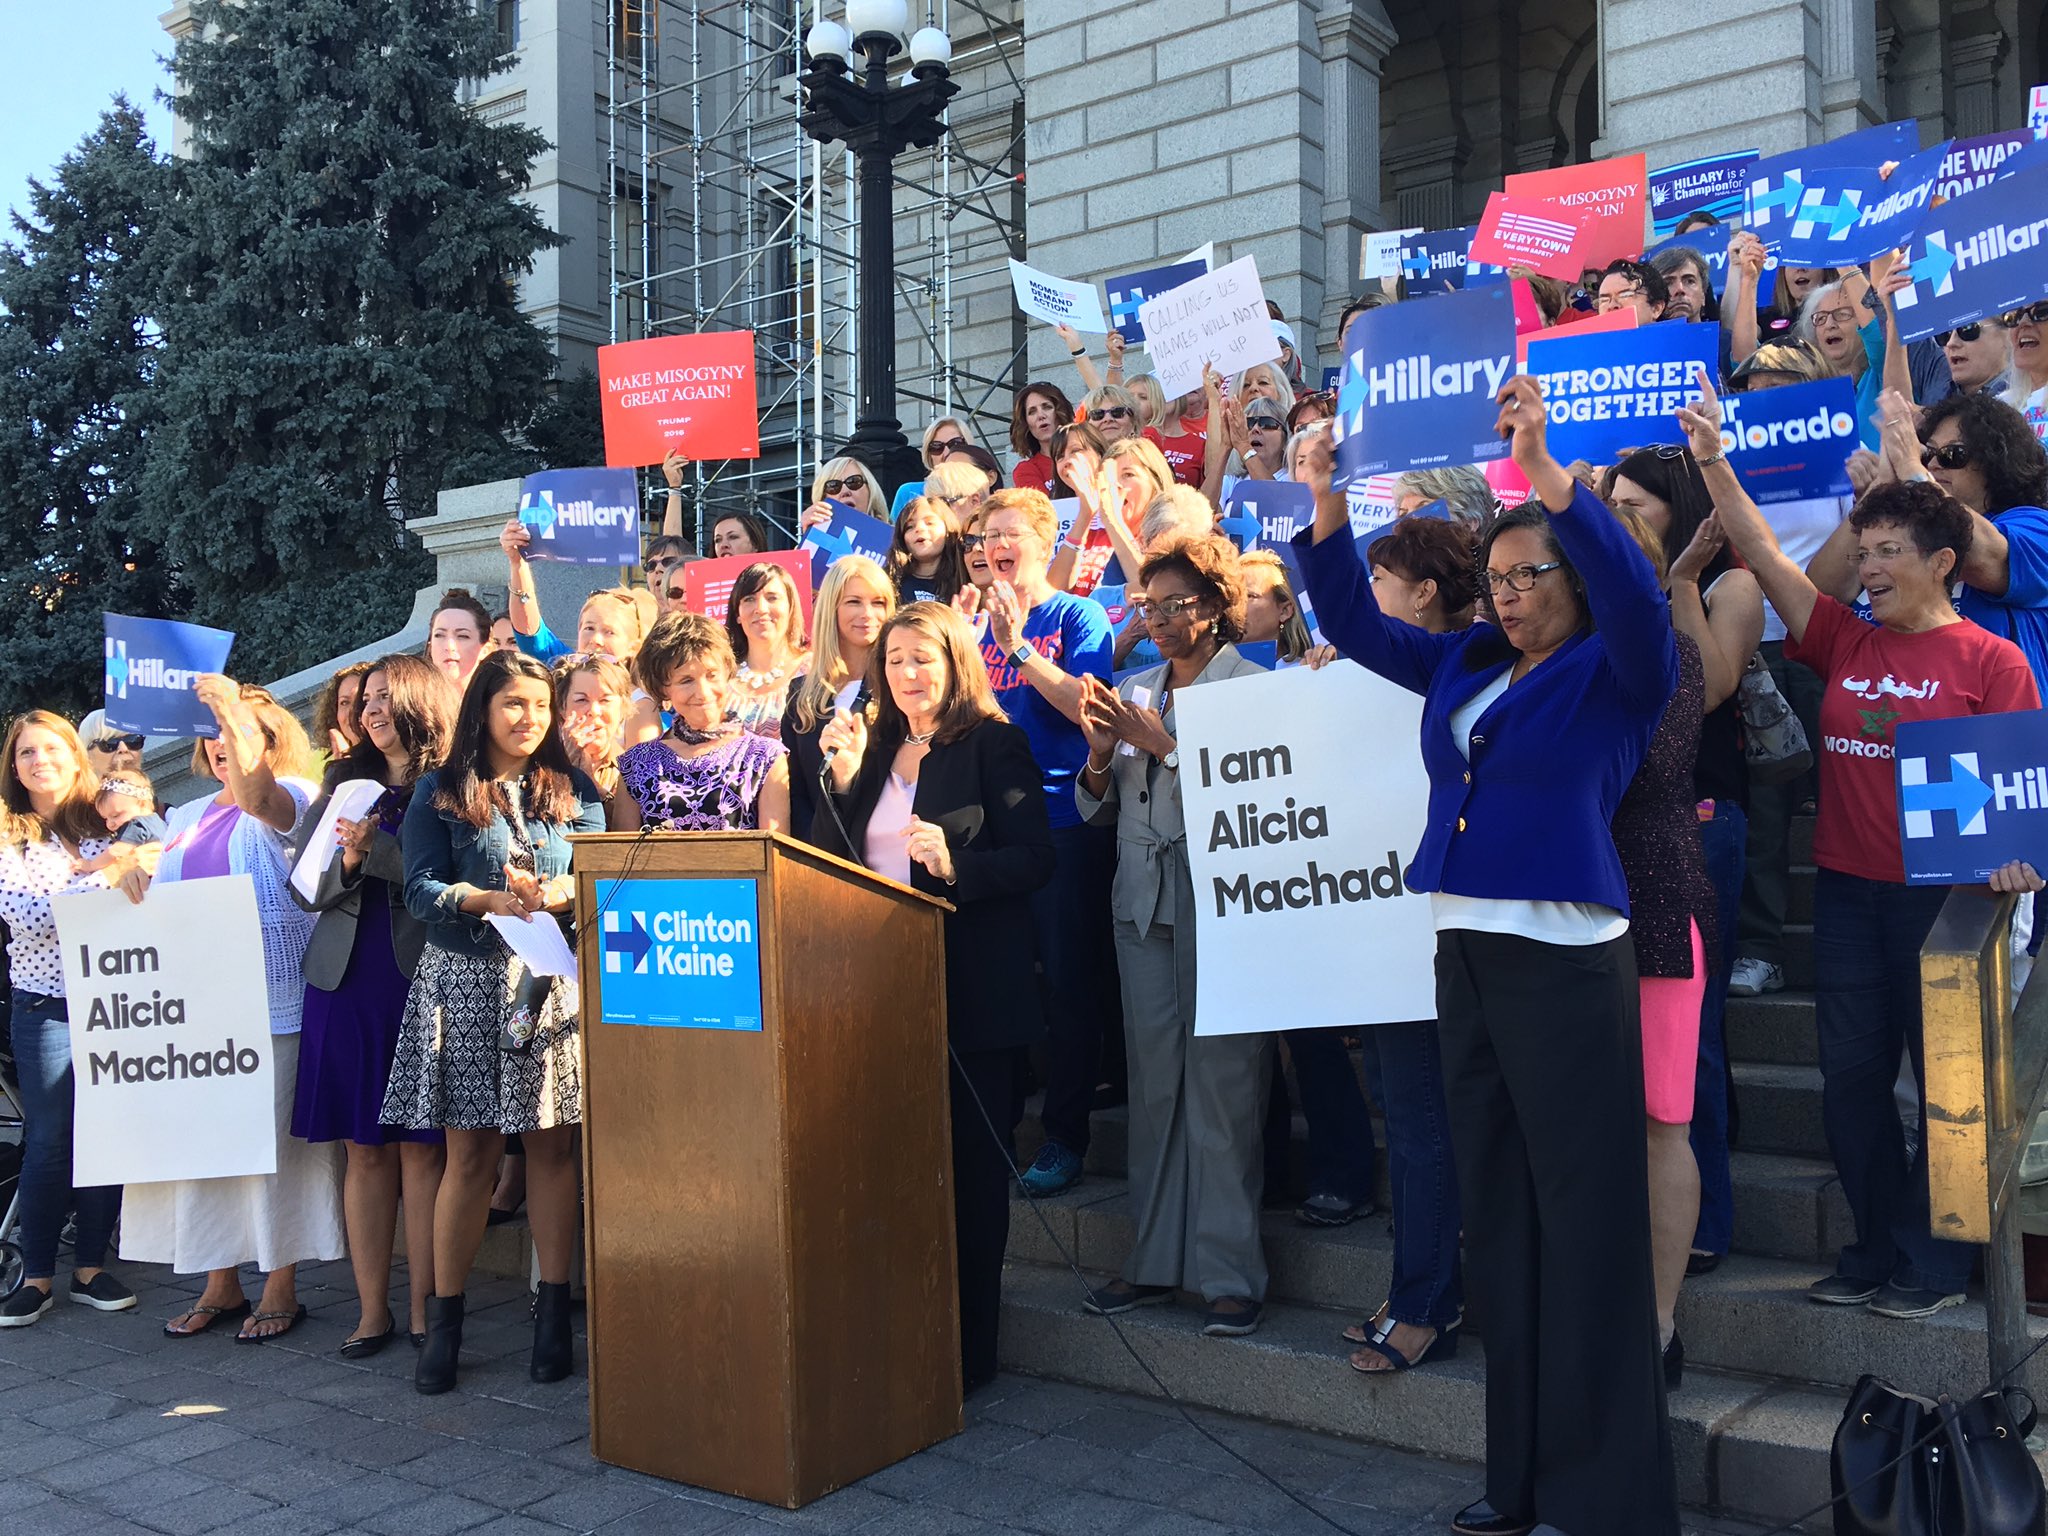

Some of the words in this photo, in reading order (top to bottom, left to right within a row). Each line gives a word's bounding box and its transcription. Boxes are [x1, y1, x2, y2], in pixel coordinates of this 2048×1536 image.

[1673, 170, 1724, 190] HILLARY
[1727, 168, 1737, 179] is
[1938, 151, 1966, 179] HE
[1559, 184, 1639, 207] MISOGYNY
[1859, 178, 1935, 227] Hillary
[1493, 229, 1571, 254] EVERYTOWN
[1954, 217, 2048, 272] Hillar
[1029, 280, 1058, 297] MOMS
[1031, 288, 1073, 307] DEMAND
[1033, 296, 1069, 314] ACTION
[1148, 288, 1212, 335] CALLING
[1217, 278, 1240, 298] US
[1153, 331, 1200, 361] NAMES
[1201, 316, 1231, 338] WILL
[1233, 301, 1261, 324] NOT
[1161, 359, 1197, 386] SHUT
[1230, 336, 1247, 354] UP
[608, 372, 652, 392] MAKE
[655, 365, 746, 385] MISOGYNY
[1369, 354, 1512, 408] Hillary
[1536, 360, 1707, 398] STRONGER
[621, 389, 669, 408] GREAT
[672, 384, 731, 402] AGAIN!
[657, 416, 692, 426] TRUMP
[664, 429, 685, 438] 2016
[1720, 405, 1854, 454] olorado
[557, 500, 637, 532] Hillary
[1346, 501, 1394, 519] VERY
[1353, 520, 1370, 528] FOR
[705, 603, 729, 618] EVE
[1842, 673, 1940, 700] المغرب
[1199, 747, 1212, 788] I
[1219, 744, 1293, 784] am
[1208, 797, 1330, 853] Alicia
[653, 909, 752, 943] Clinton
[81, 944, 91, 979] I
[98, 945, 159, 976] am
[656, 944, 735, 977] Kaine
[86, 991, 186, 1033] Alicia
[89, 1038, 260, 1086] Machado
